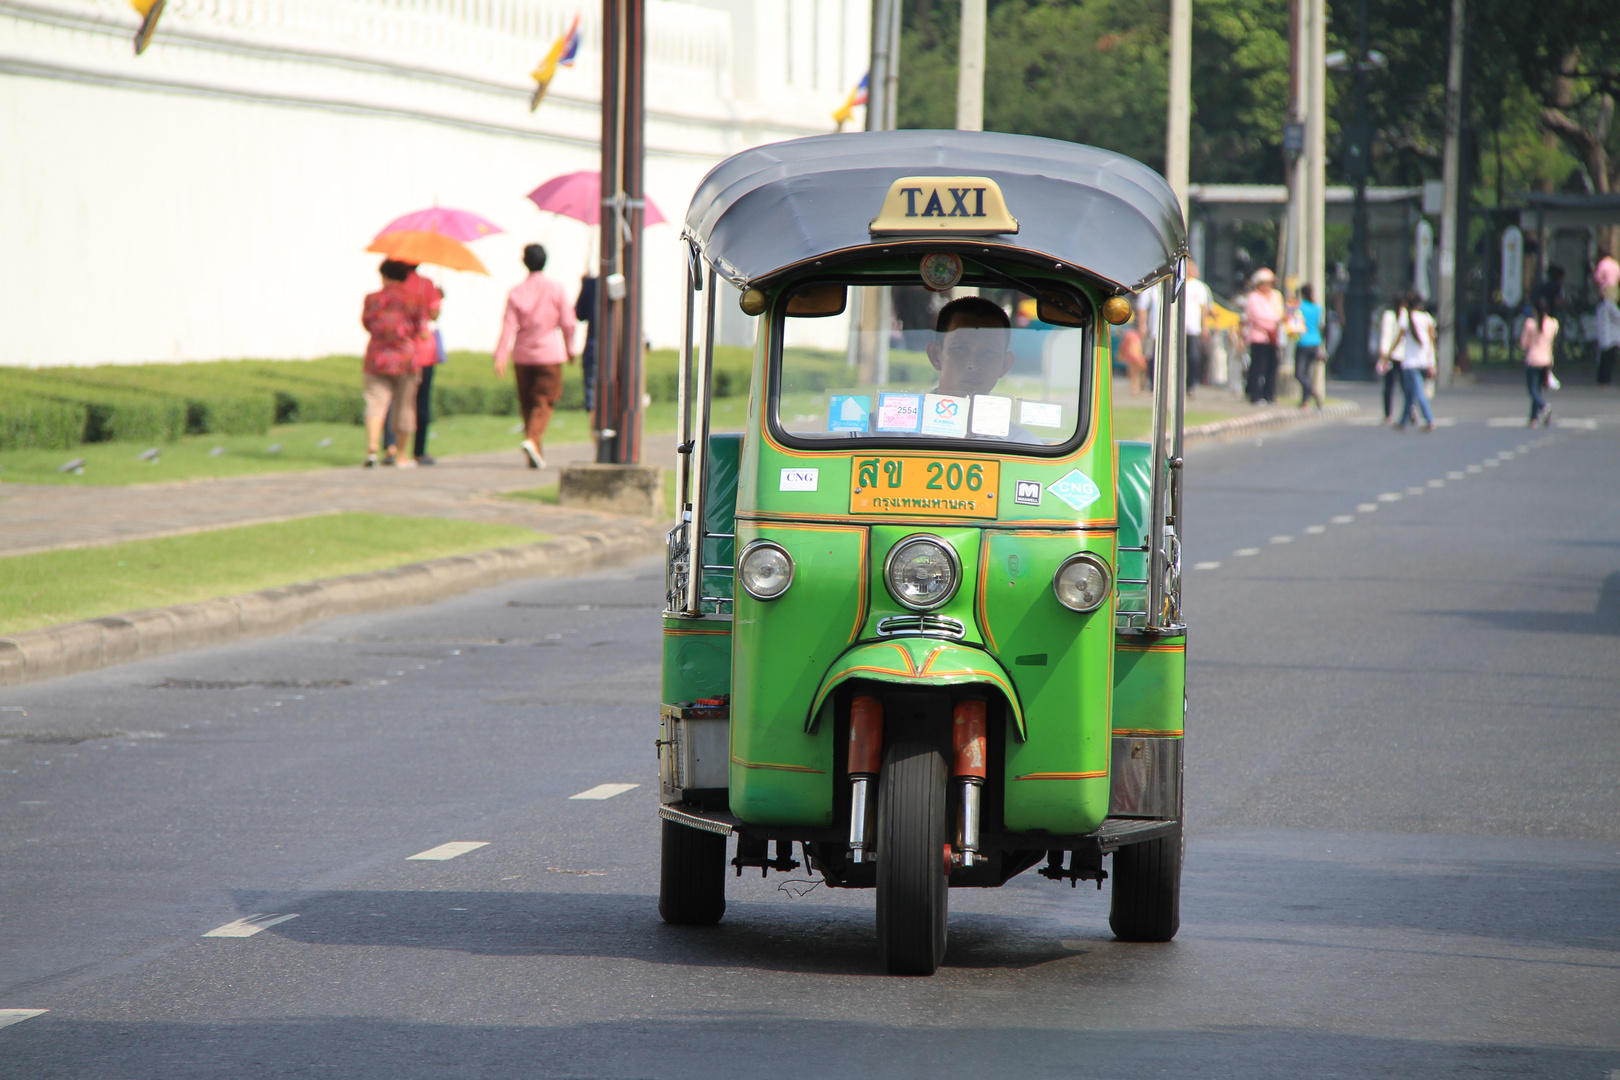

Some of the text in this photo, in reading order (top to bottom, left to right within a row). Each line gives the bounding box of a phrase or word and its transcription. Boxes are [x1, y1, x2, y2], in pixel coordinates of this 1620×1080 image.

[900, 187, 987, 217] TAXI
[897, 406, 917, 415] 2554
[786, 472, 814, 482] CNG
[859, 458, 984, 491] สข 206
[1018, 482, 1039, 498] M
[1058, 481, 1094, 495] CNG
[873, 497, 977, 511] กรุงเทพมหานคร
